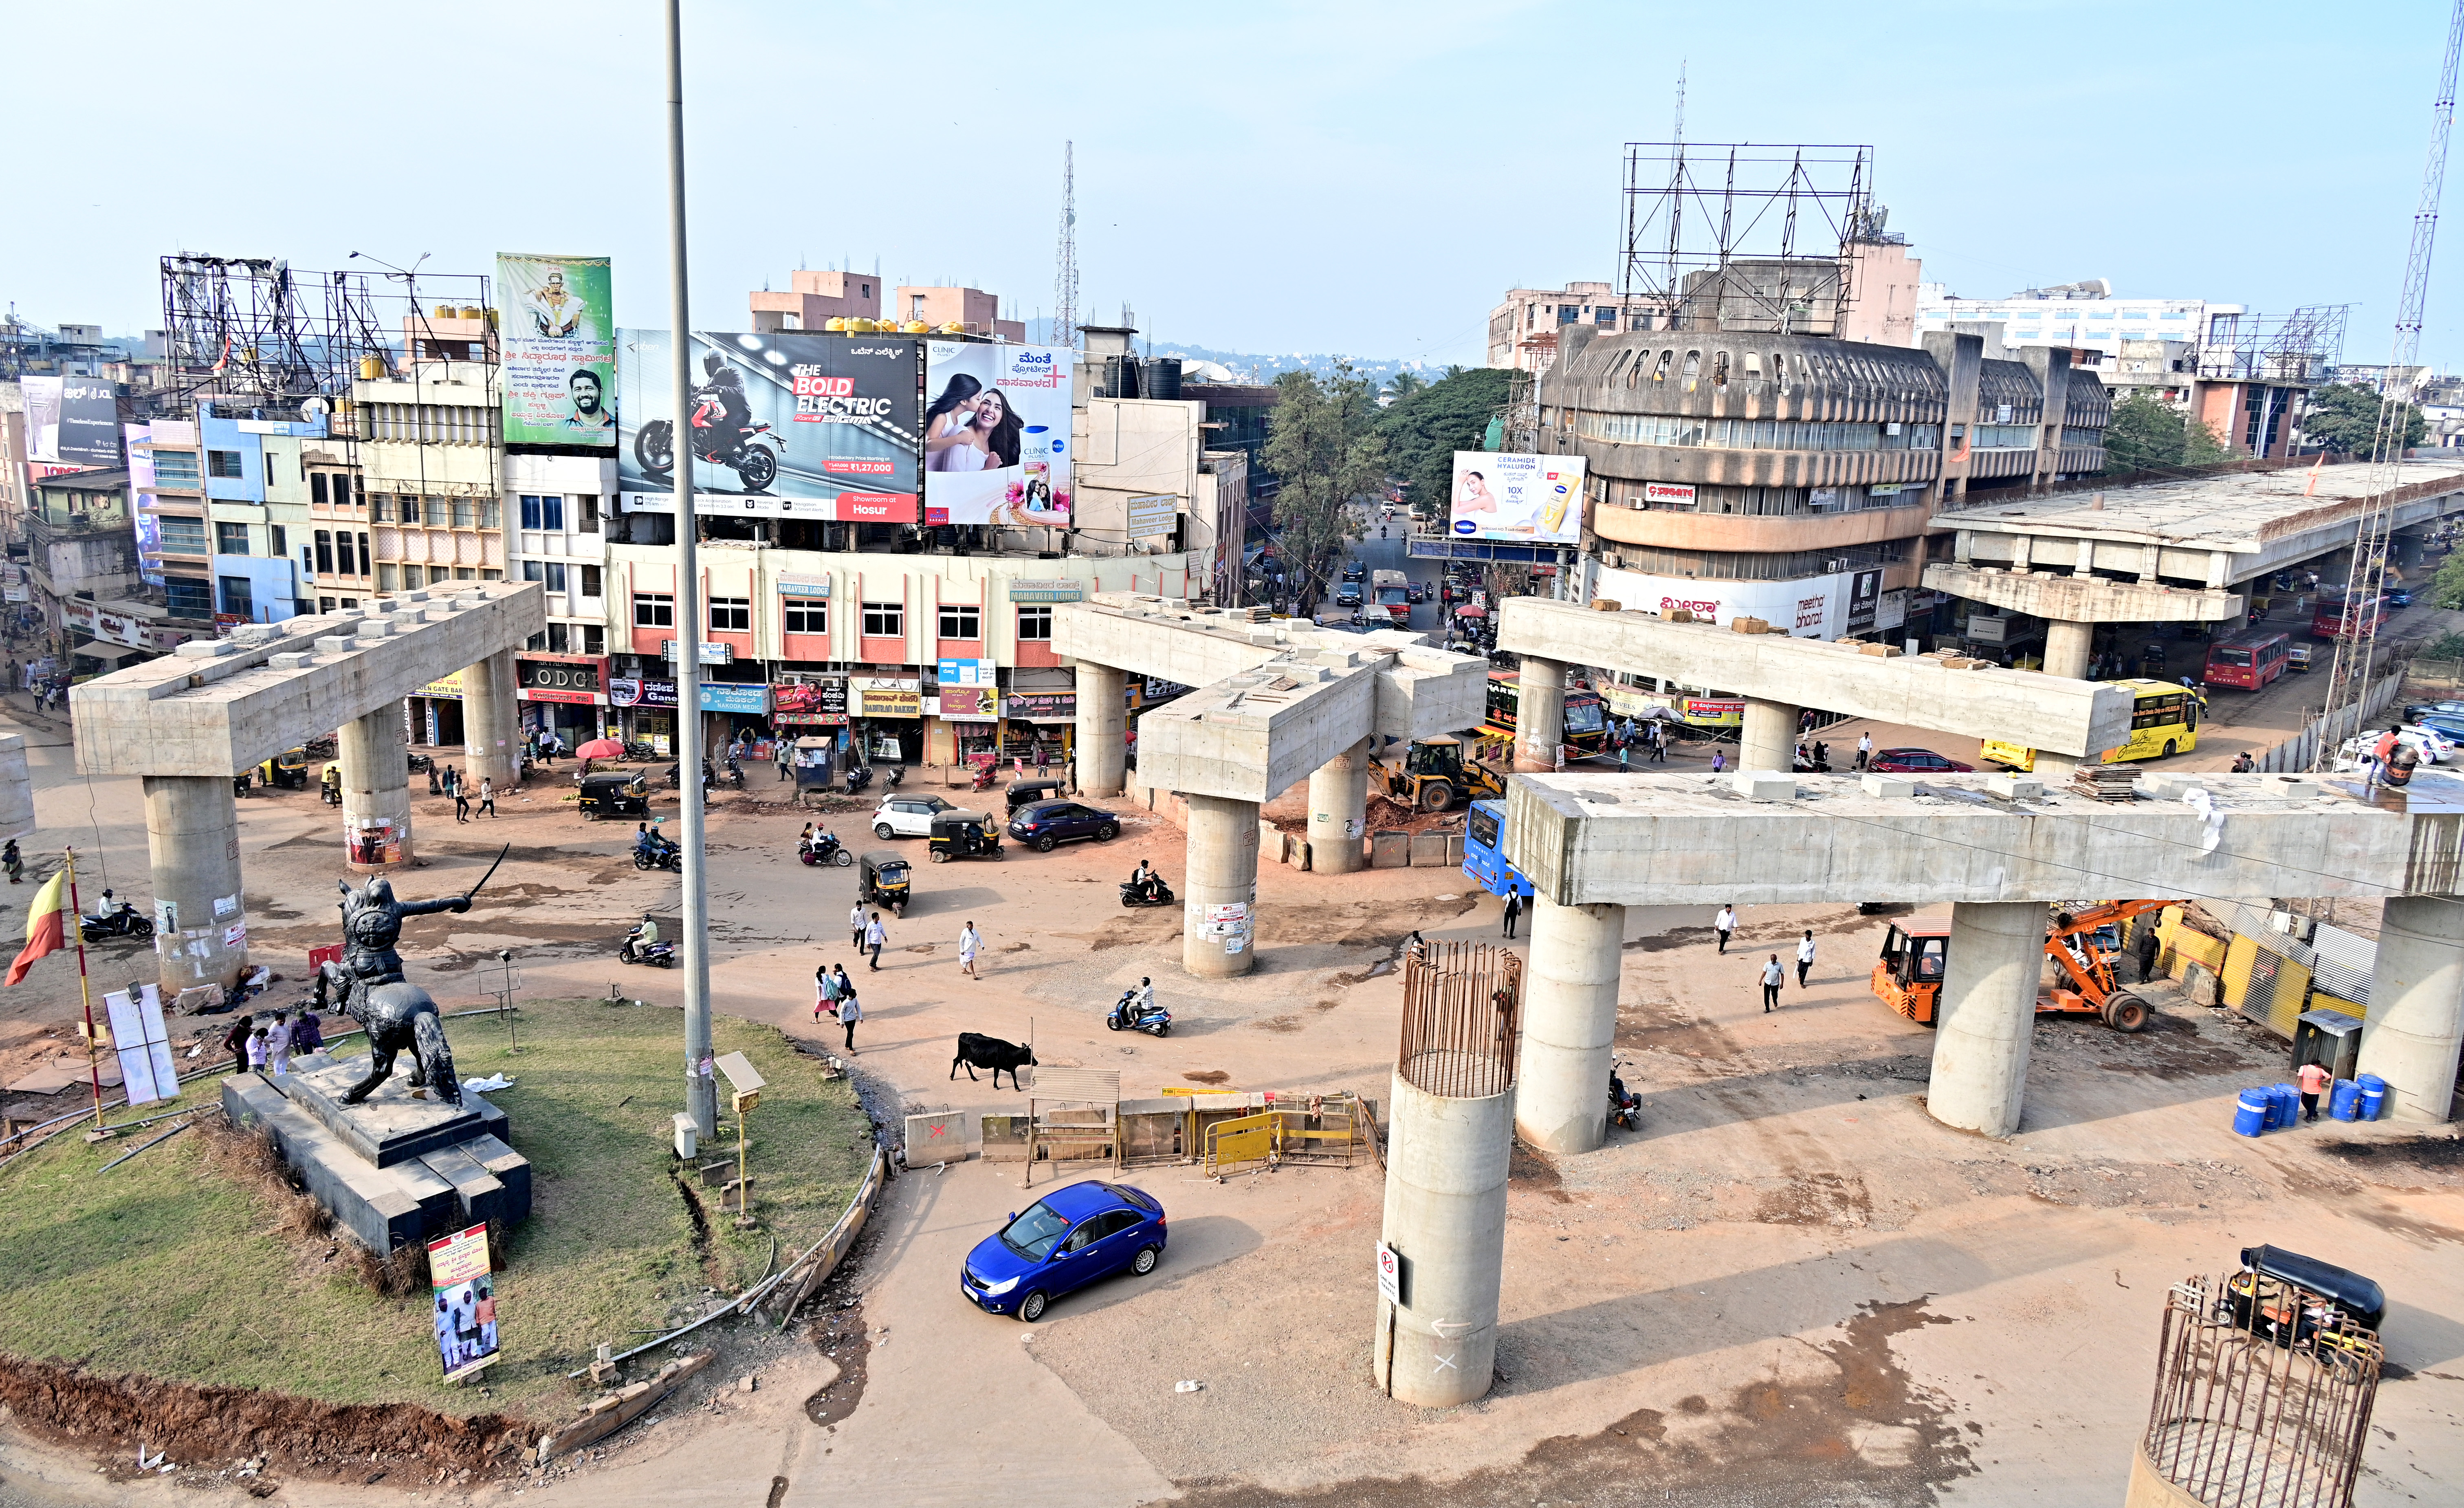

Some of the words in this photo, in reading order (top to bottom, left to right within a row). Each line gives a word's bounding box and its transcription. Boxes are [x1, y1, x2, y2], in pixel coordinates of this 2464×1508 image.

[504, 351, 517, 361] ಶ್ರೀ
[572, 354, 612, 365] ಸ್ವಾಮಿಗಳ
[875, 347, 903, 359] ಎಲೆಕ್ಟ್ರಿಕ್
[1019, 352, 1052, 364] ಮೆಂತೆ
[795, 363, 821, 376] THE
[1012, 364, 1051, 375] ಪ್ರೋಟೀನ್
[795, 377, 851, 396] BOLD
[996, 377, 1051, 388] ದಾಸವಾಳದ
[64, 386, 87, 399] ಜಲ್
[98, 389, 113, 399] JAL
[508, 391, 519, 399] ಶ್ರೀ
[523, 391, 536, 400] ಶಕ್ತಿ
[795, 395, 892, 415] ELECTRIC
[66, 418, 114, 426] #TimelessExperiences
[821, 415, 872, 424] SIGMA
[1507, 486, 1523, 495] 10X
[1657, 487, 1693, 497] SUGATE
[853, 504, 887, 515] Hosur
[1131, 498, 1158, 511] ಮಹಾವೀರ
[1132, 516, 1157, 526] Mahaveer
[1158, 514, 1175, 523] Lodge
[780, 572, 810, 583] ಮಹಾವೀರ
[778, 584, 809, 594] MAHAVEER
[810, 586, 828, 595] LODGE
[1012, 581, 1054, 589] ಮಹಾವೀರ
[1011, 592, 1054, 601] MAHAVEER
[1056, 592, 1081, 600] LODGE
[1798, 594, 1825, 612] meetha
[1796, 609, 1822, 629] bharat
[1848, 614, 1861, 627] PRABHU
[1860, 612, 1877, 624] MEDICALS
[644, 682, 673, 692] ಗಣೇಶ
[726, 695, 756, 703] ಮೆಡಿಕಲ್
[899, 694, 918, 702] ಬೇಕರಿ
[864, 704, 893, 713] BABURAO
[1608, 698, 1636, 710] TRAVELS
[2125, 746, 2148, 755] EXPERIENCE
[1381, 1281, 1395, 1297] TRAFFIC
